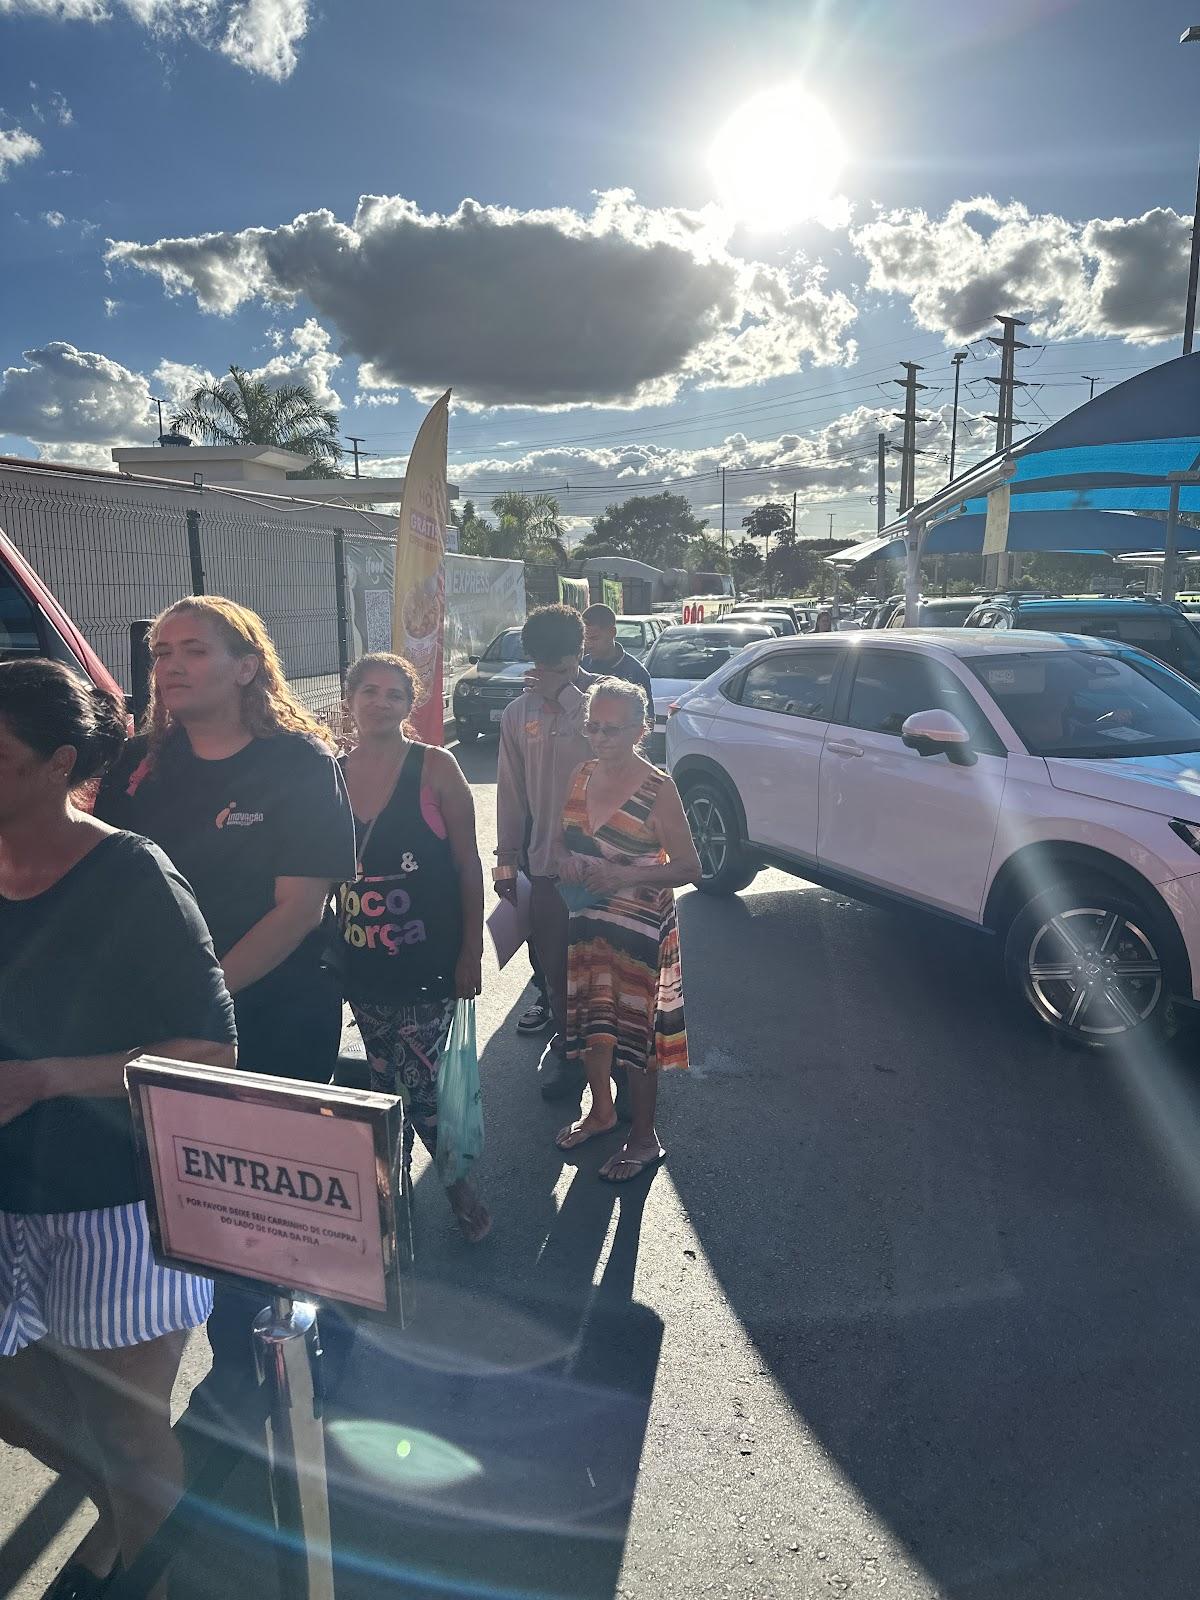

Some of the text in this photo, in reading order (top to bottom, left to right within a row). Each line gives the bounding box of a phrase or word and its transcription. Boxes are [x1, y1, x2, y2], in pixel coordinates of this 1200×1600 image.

[401, 852, 419, 872] &
[182, 1146, 352, 1210] ENTRADA
[186, 1197, 358, 1243] POR FAVOR DEIXE SEU CARRINHO DE COMPRA
[221, 1216, 320, 1247] DO LADO DE FORA DA FILA
